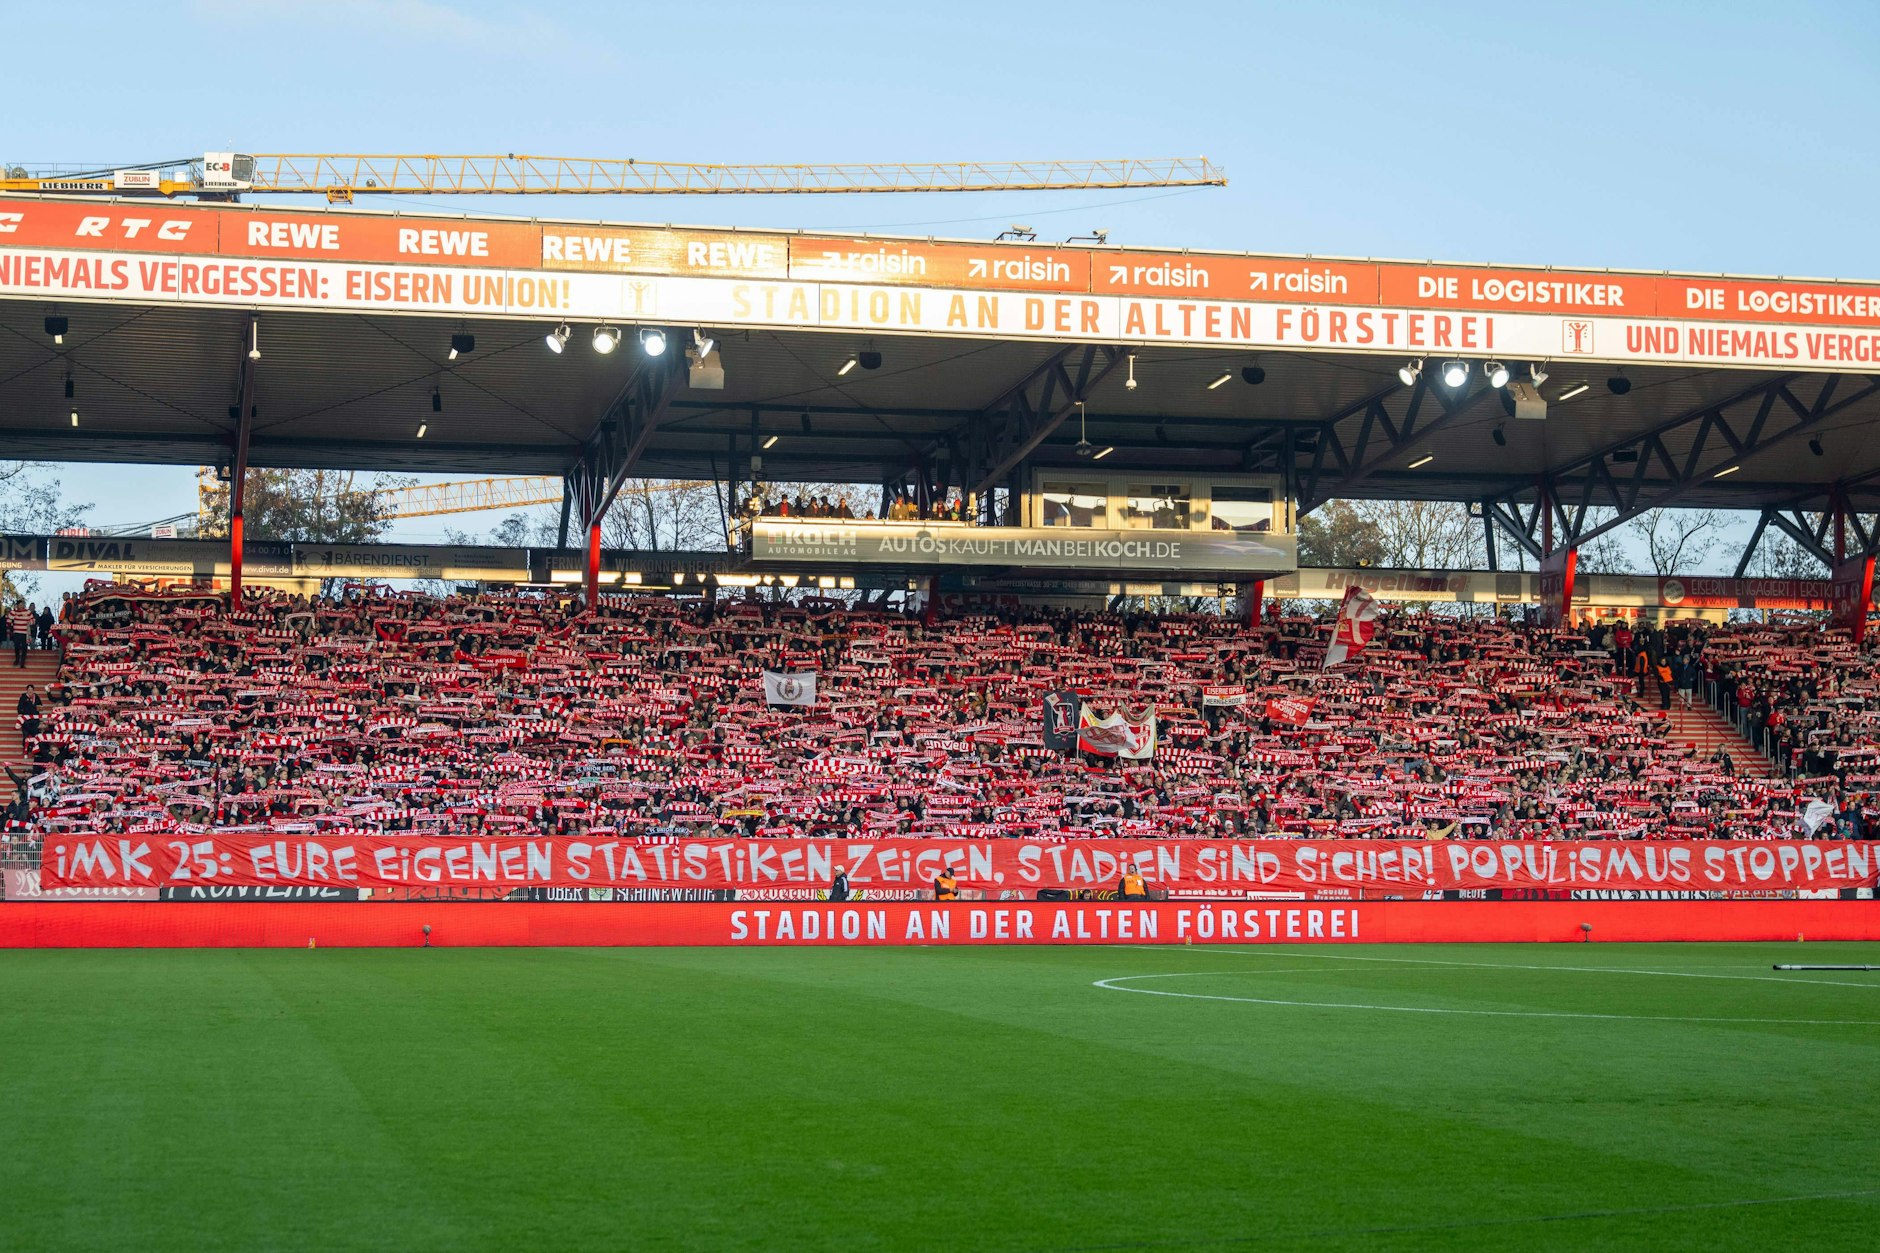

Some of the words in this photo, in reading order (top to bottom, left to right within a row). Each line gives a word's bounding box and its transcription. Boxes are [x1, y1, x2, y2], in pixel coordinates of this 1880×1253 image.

[205, 162, 230, 172] EC-B
[248, 221, 340, 250] REWE
[398, 228, 489, 257] REWE
[543, 235, 631, 263] REWE
[687, 241, 775, 269] REWE
[846, 247, 926, 275] raisin
[994, 255, 1070, 283] raisin
[0, 255, 129, 290] NIEMALS
[139, 260, 329, 300] VERGESSEN:
[346, 270, 452, 304] EISERN
[462, 275, 571, 309] UNION!
[1133, 261, 1209, 289] raisin
[1273, 267, 1347, 294] raisin
[1418, 276, 1459, 299] DIE
[1472, 278, 1625, 307] LOGISTIKER
[1686, 287, 1725, 311] DIE
[1738, 289, 1880, 318] LOGISTIKER
[731, 283, 922, 326] STADION
[946, 294, 1000, 329] AN
[1025, 297, 1101, 334] DER
[1124, 301, 1251, 339] ALTEN
[1276, 306, 1494, 349] FÖRSTEREI
[1626, 325, 1679, 354] UND
[1688, 328, 1799, 359] NIEMALS
[55, 541, 136, 561] DIVAL
[768, 546, 839, 555] AUTOMOBILE
[786, 529, 857, 546] KOCH
[0, 561, 23, 569] GUNG
[137, 564, 192, 572] VERSICHERUNGEN
[335, 552, 429, 567] BÄRENDIENST
[169, 840, 233, 880] 25:
[250, 840, 358, 881] EURE
[730, 909, 886, 940] STADION
[905, 909, 951, 939] AN
[969, 909, 1034, 939] DER
[1052, 908, 1158, 939] ALTEN
[1177, 903, 1358, 938] FÖRSTEREI
